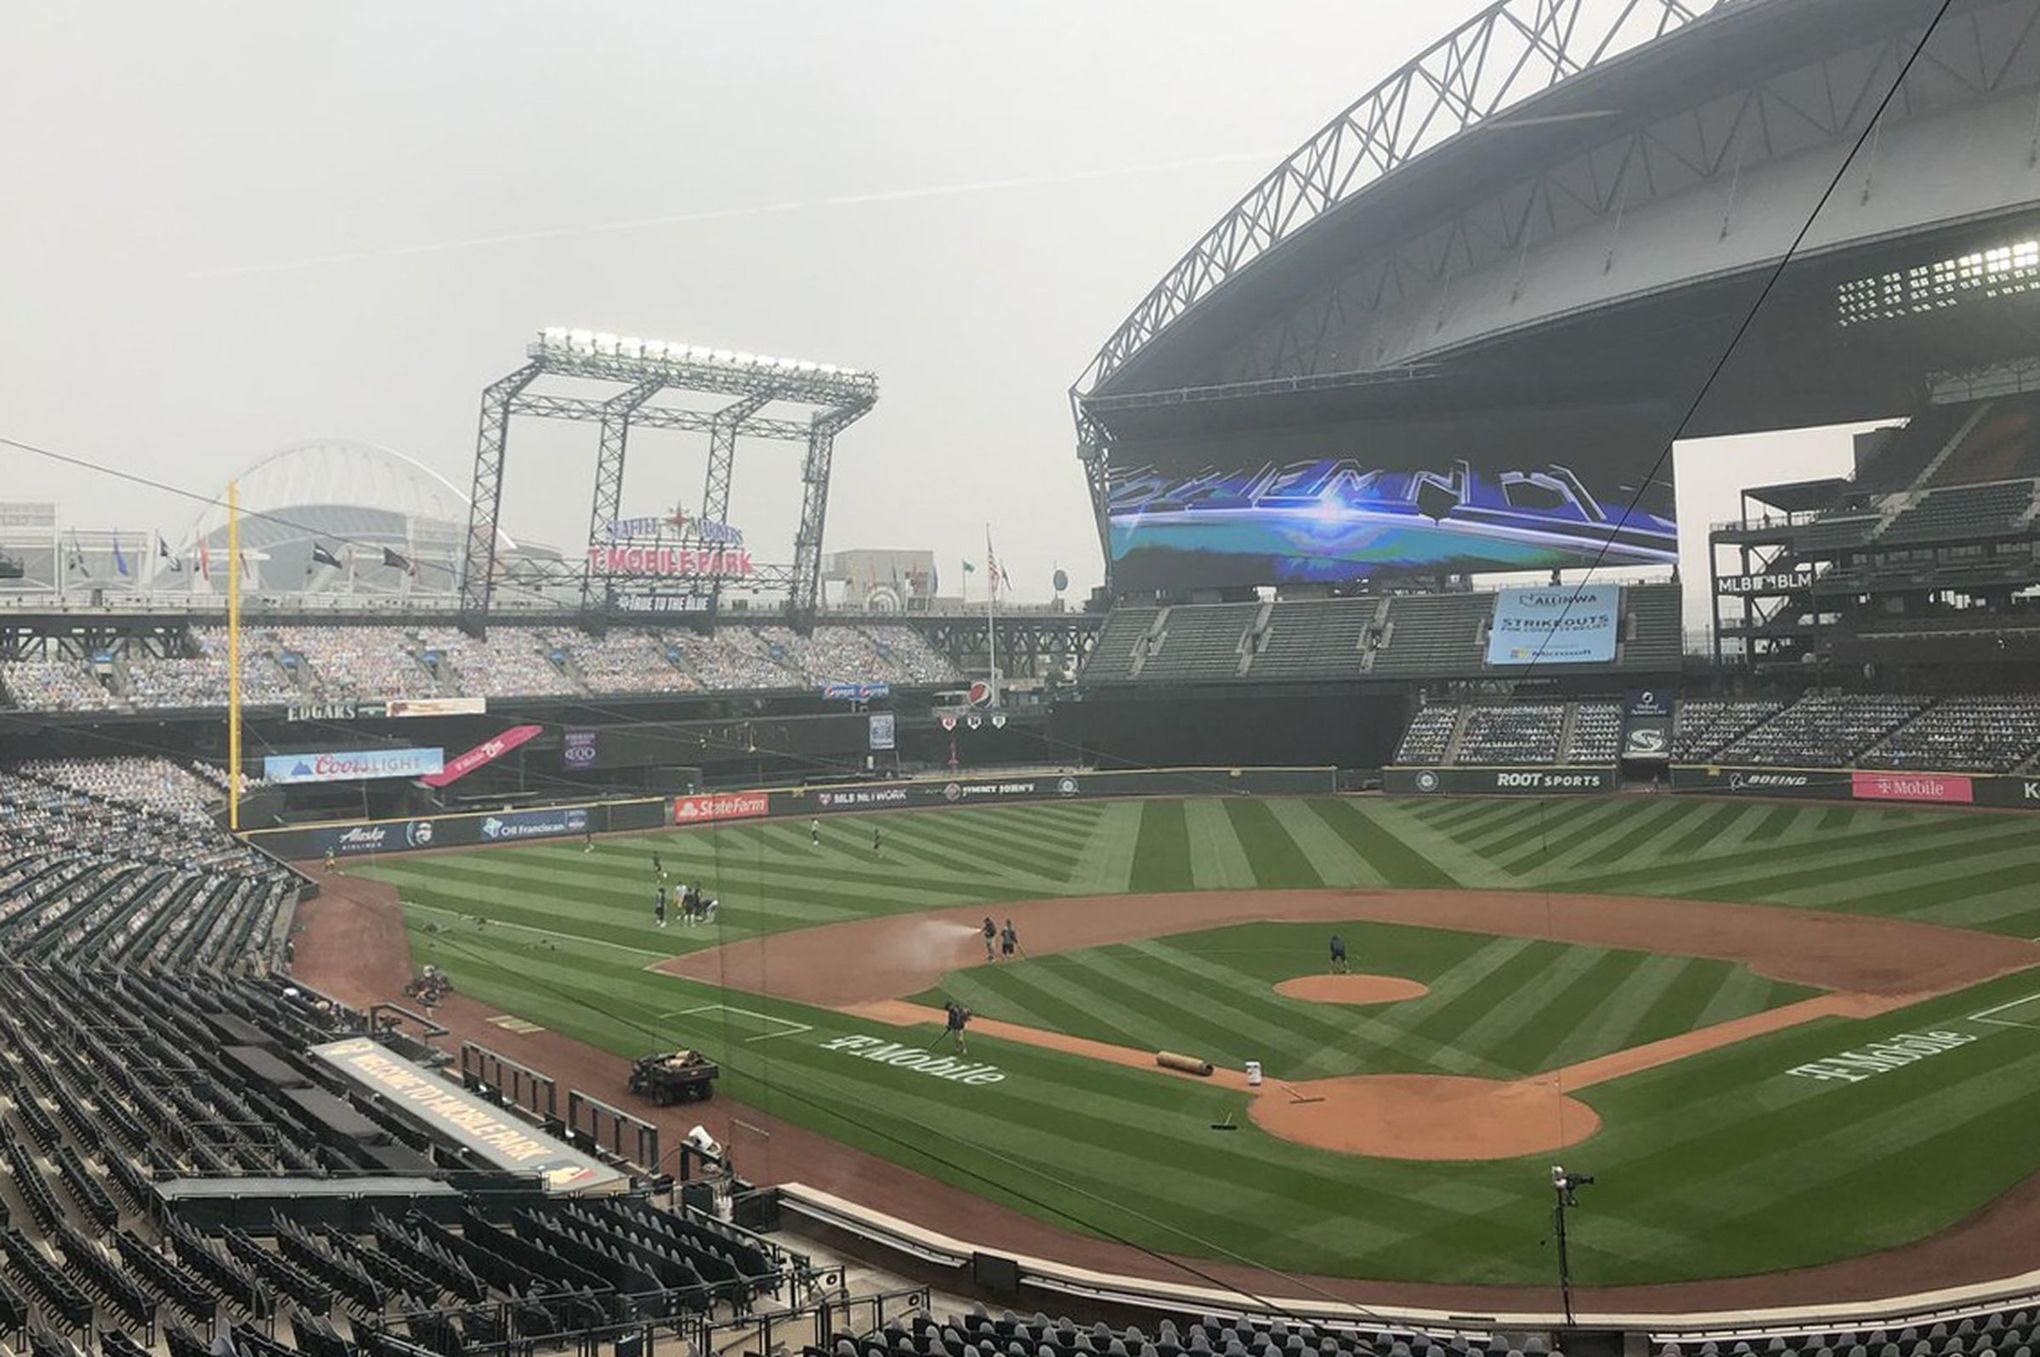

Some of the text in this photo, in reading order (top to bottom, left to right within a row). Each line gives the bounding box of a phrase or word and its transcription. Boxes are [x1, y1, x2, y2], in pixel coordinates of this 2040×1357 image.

[694, 549, 754, 576] PARK
[1719, 574, 1812, 592] MLB BLM
[1503, 615, 1610, 628] STRIKEOUTS
[1532, 649, 1592, 657] Microsoft
[315, 753, 421, 775] Coors LIGHT
[1497, 773, 1600, 787] ROOT SPORTS
[1748, 775, 1808, 786] BOEING
[857, 789, 908, 803] NETWORK
[339, 826, 386, 843] Alaska
[481, 1129, 555, 1162] PARK
